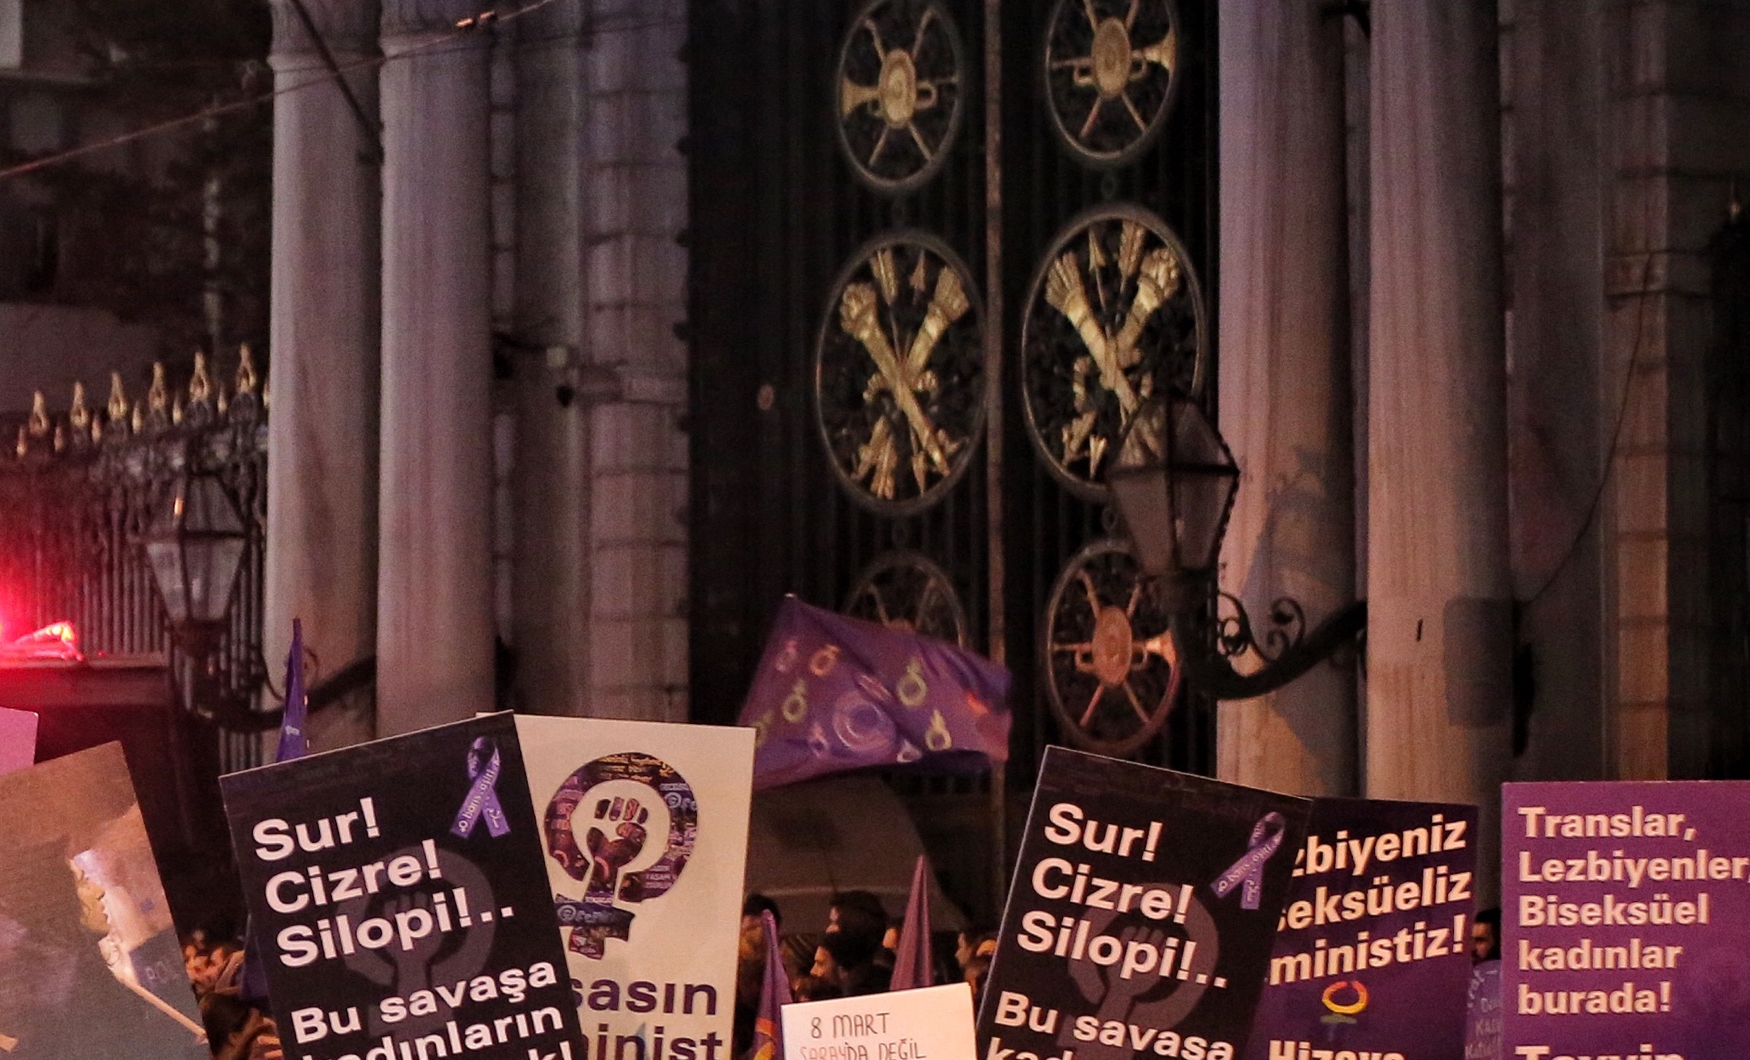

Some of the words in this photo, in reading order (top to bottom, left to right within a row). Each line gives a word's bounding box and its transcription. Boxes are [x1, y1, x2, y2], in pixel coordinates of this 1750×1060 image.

[253, 797, 379, 860] Sur!
[1045, 803, 1162, 861] Sur!
[1518, 806, 1695, 840] Translar,
[266, 834, 445, 913] Cizre!
[1033, 858, 1193, 927] Cizre!
[1277, 866, 1472, 932] eksüeliz
[277, 883, 513, 966] Silopi!..
[1520, 893, 1707, 926] Biseksüel
[1018, 906, 1226, 987] Silopi!..
[1519, 939, 1682, 970] kadınlar
[292, 1007, 361, 1043] Bu
[380, 962, 556, 1022] savaşa
[811, 1017, 822, 1038] 8
[833, 1013, 890, 1038] MART
[995, 991, 1057, 1033] Bu
[1518, 982, 1670, 1014] burada!
